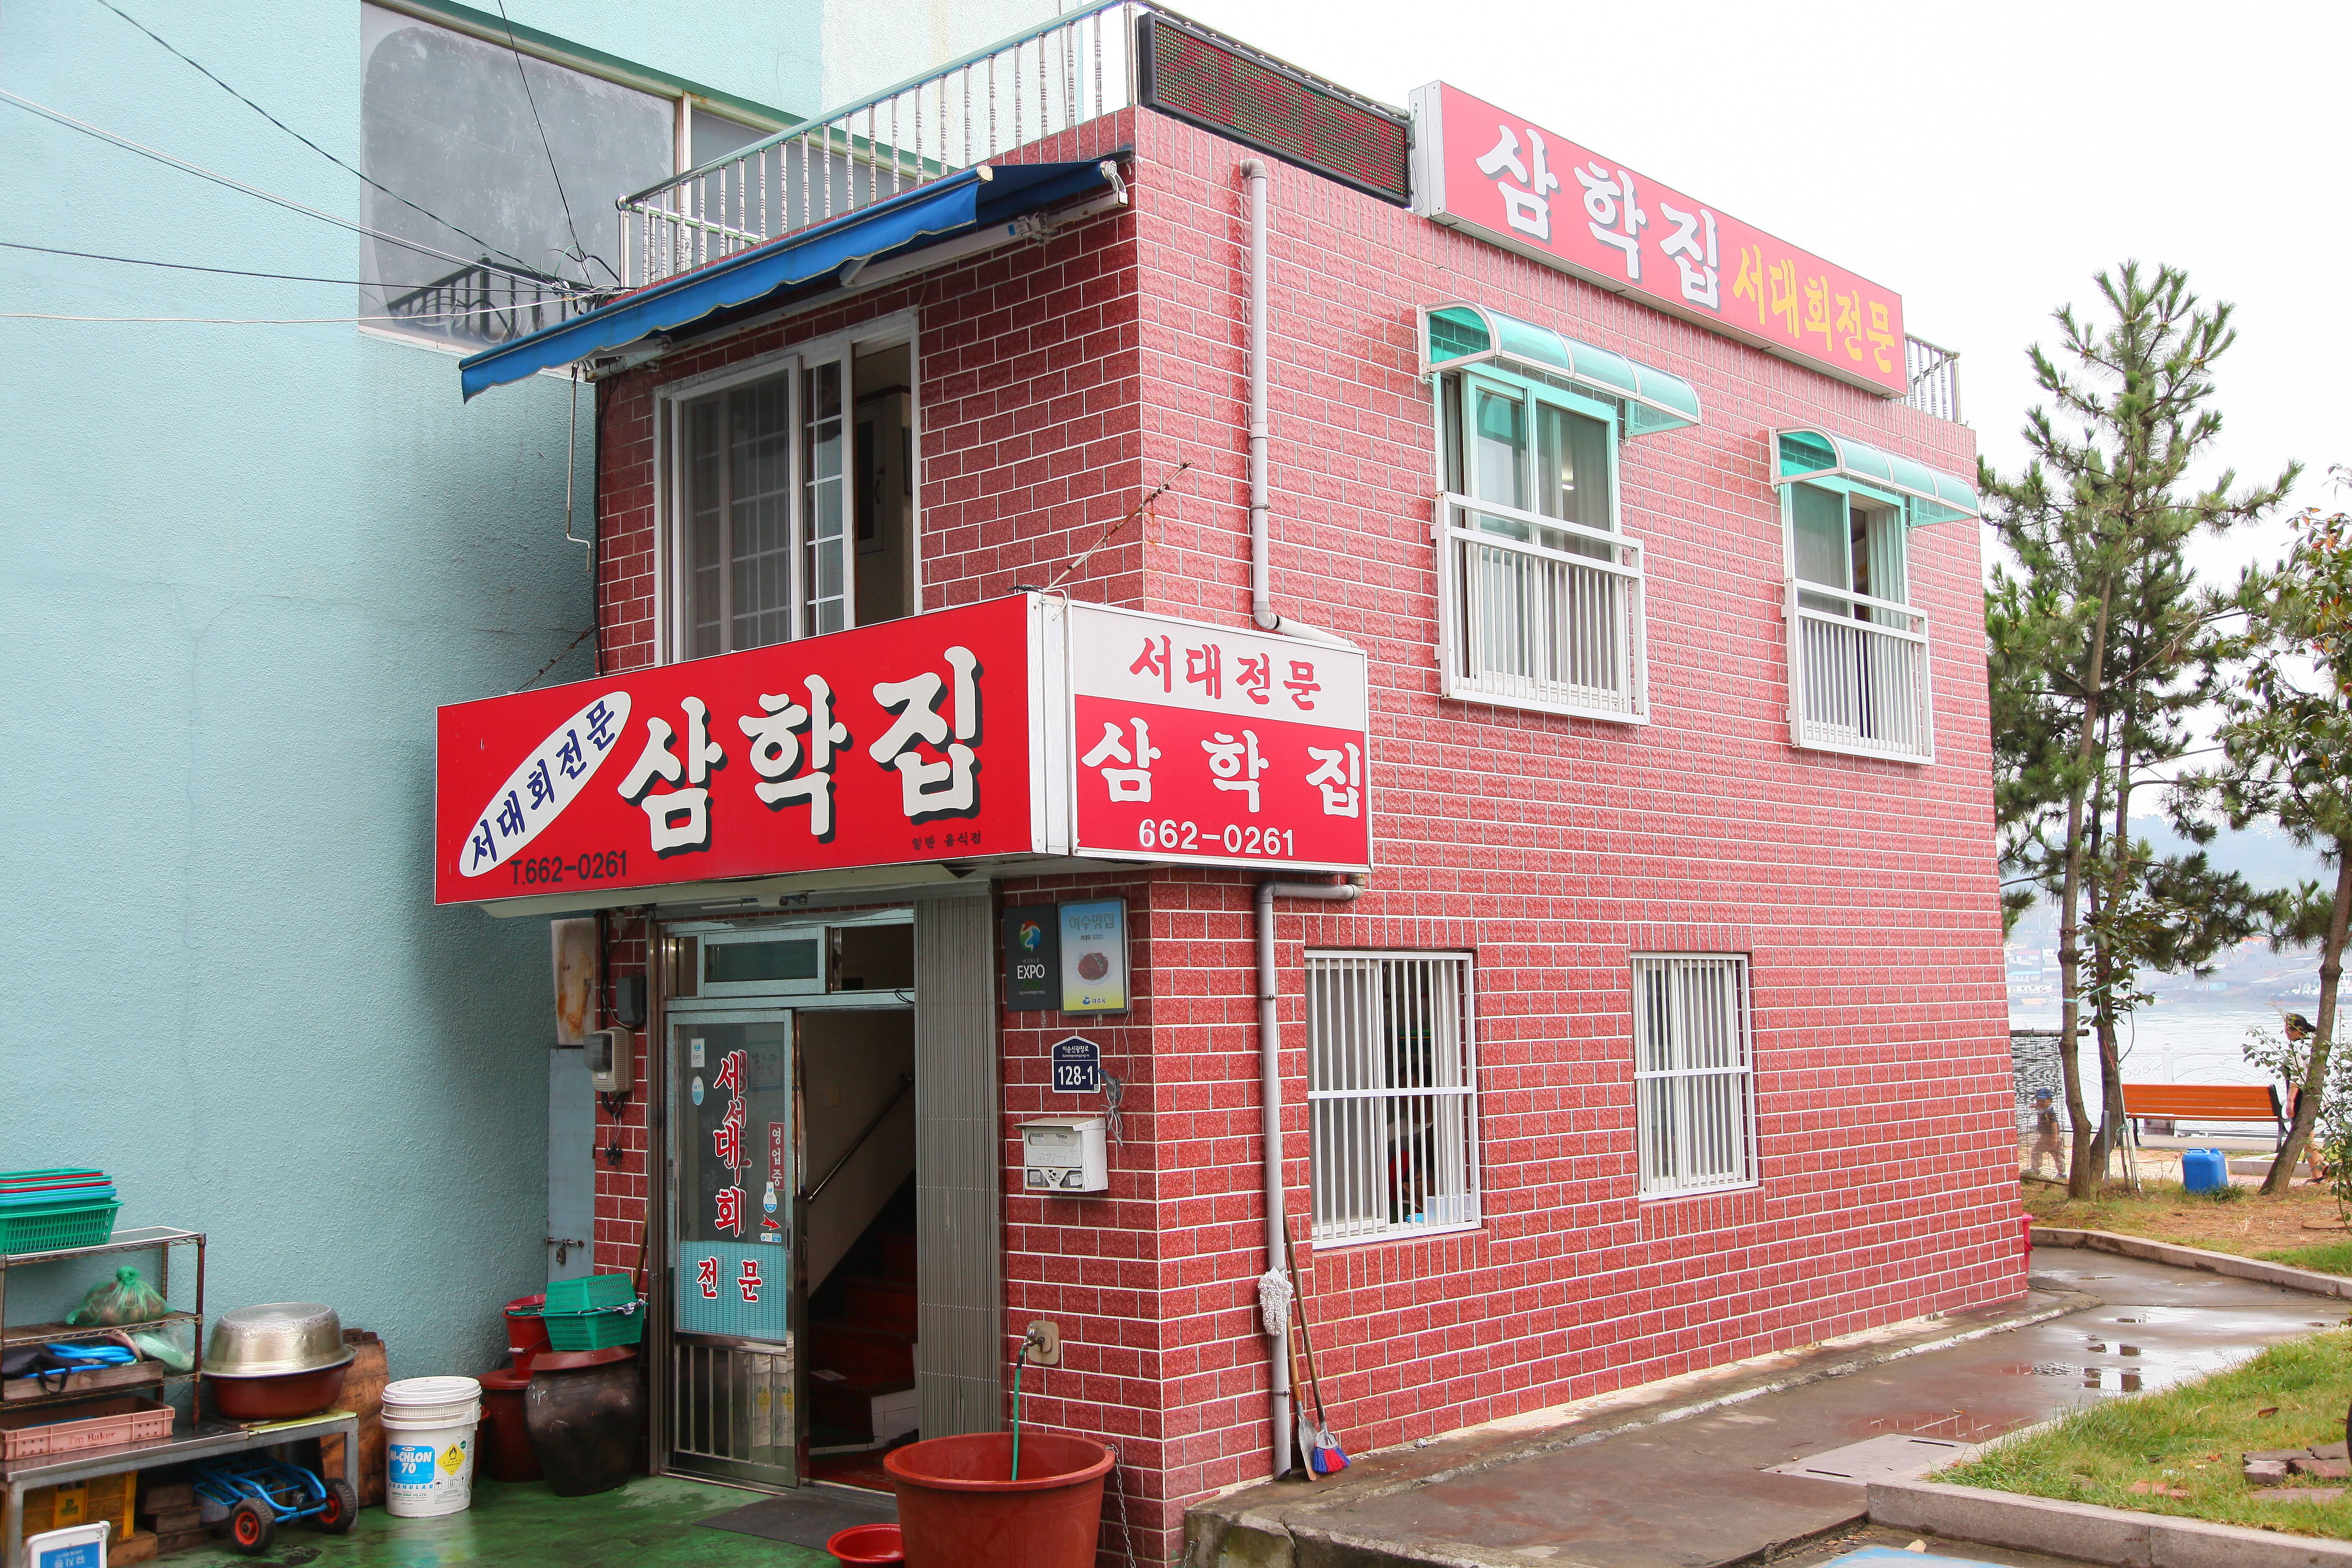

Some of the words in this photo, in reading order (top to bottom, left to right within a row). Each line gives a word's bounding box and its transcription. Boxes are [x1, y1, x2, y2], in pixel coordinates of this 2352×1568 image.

[1475, 124, 1721, 309] 삼학집
[1733, 245, 1896, 374] 서대회전문
[1129, 634, 1321, 711] 서대전문
[617, 645, 978, 852] 삼학집
[472, 700, 616, 870] 서대회전문
[1081, 717, 1361, 818] 삼학집
[912, 836, 936, 850] 일반
[944, 830, 981, 847] 음식점
[1138, 819, 1293, 856] 662-0261
[511, 850, 627, 886] T.662-0261
[1069, 912, 1114, 931] 여수맛집
[1017, 964, 1045, 979] EXPO
[1023, 980, 1040, 989] FOOD
[1058, 1065, 1093, 1085] 128-1
[772, 1127, 782, 1186] 영업중
[697, 1256, 763, 1302] 전문
[68, 1436, 84, 1445] I'm
[87, 1432, 116, 1442] Baker
[389, 1450, 432, 1462] HI-CHLON
[401, 1462, 417, 1474] 70
